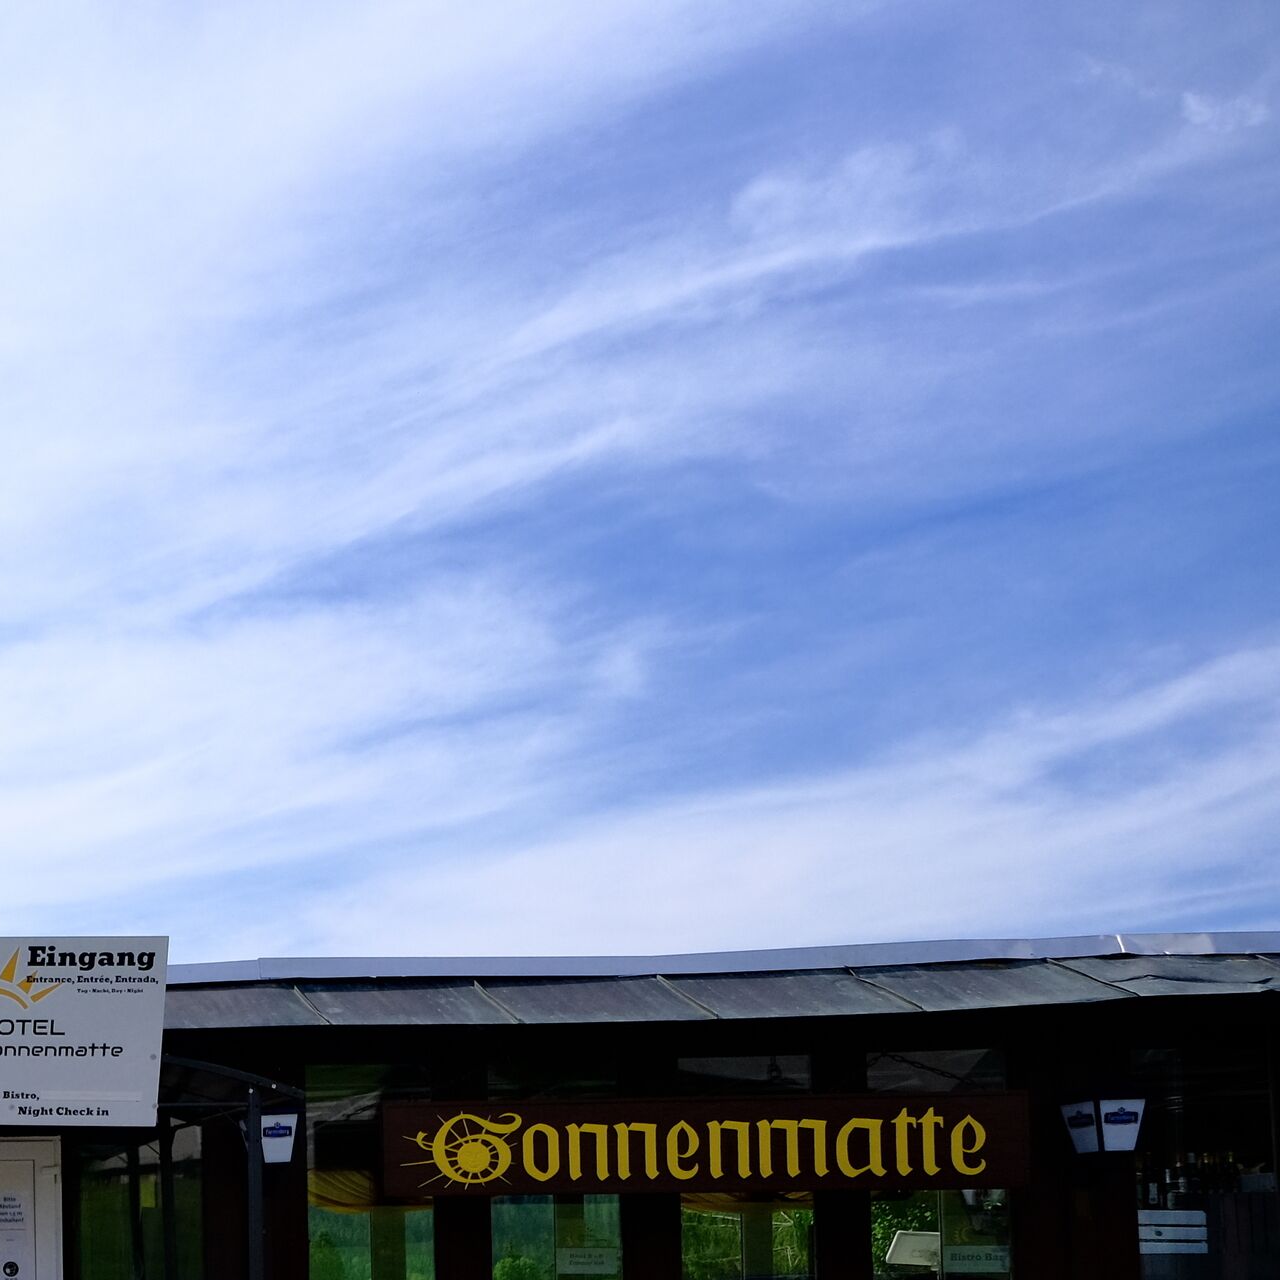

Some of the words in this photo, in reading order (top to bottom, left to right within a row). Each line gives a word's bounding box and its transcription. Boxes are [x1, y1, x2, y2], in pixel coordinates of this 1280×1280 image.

[27, 945, 156, 971] Eingang
[26, 975, 75, 985] Entrance,
[77, 974, 113, 985] Entrée,
[115, 975, 159, 985] Entrada,
[2, 1091, 40, 1100] Bistro,
[17, 1106, 53, 1117] Night
[56, 1106, 94, 1116] Check
[96, 1107, 109, 1116] in
[414, 1105, 987, 1185] Sonnenmatte
